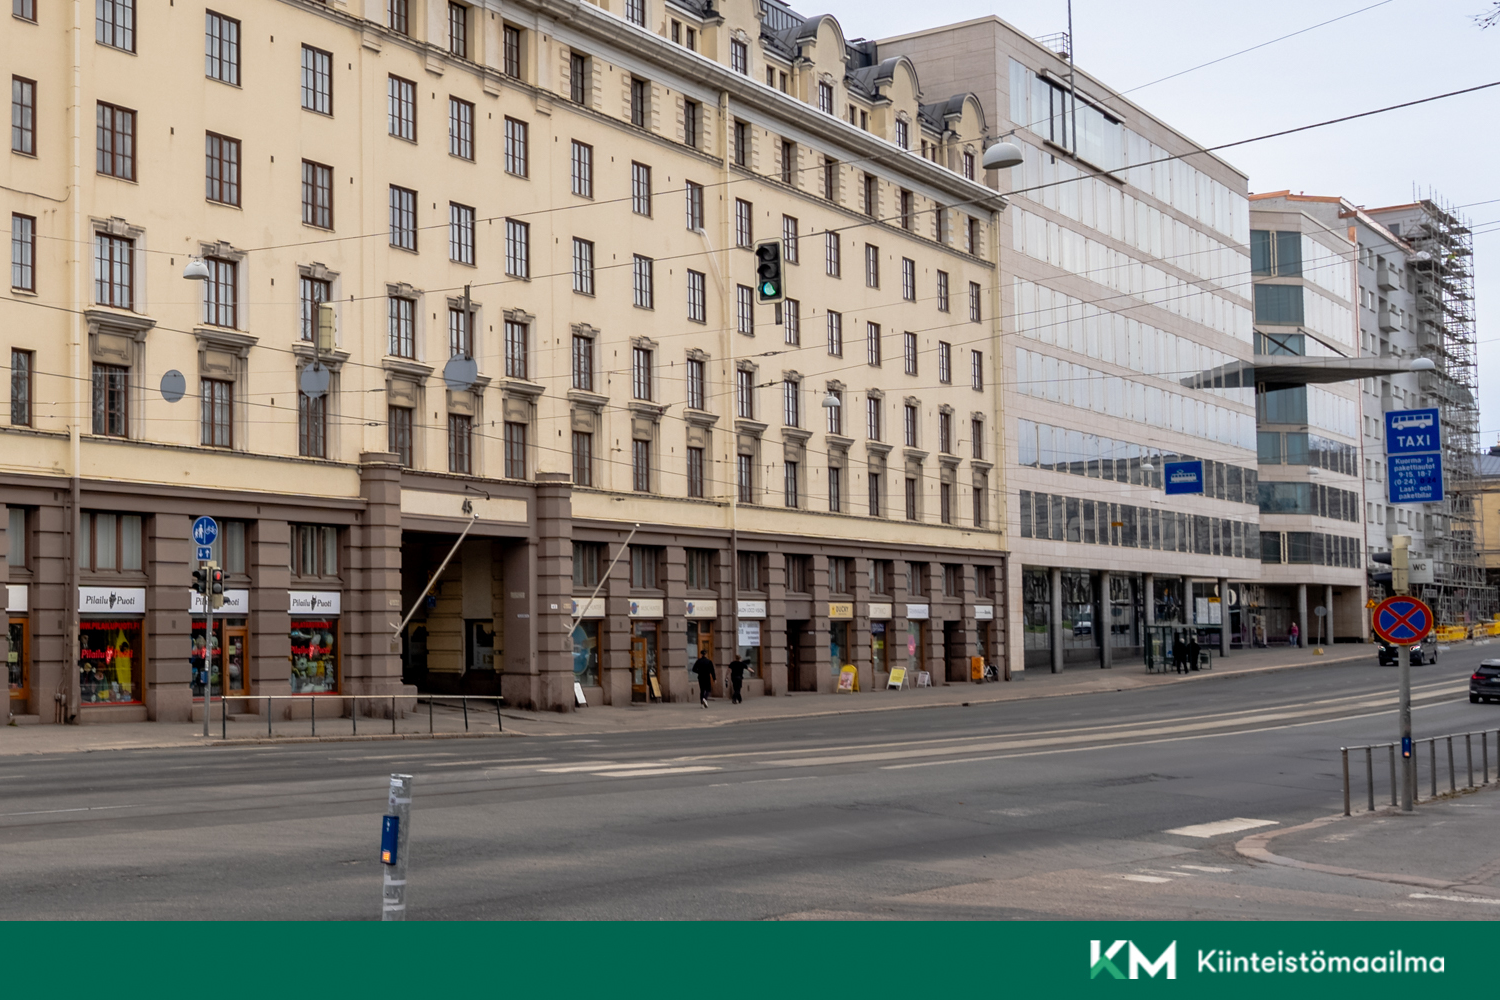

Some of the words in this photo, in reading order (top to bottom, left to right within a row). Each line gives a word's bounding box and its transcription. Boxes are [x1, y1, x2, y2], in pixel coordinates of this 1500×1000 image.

[1396, 434, 1431, 448] TAXI
[1395, 457, 1423, 465] Kuorma-
[1394, 463, 1435, 473] pakettiautot
[1399, 492, 1432, 500] paketbilar
[462, 497, 473, 514] 45
[1412, 563, 1427, 571] WC
[85, 595, 109, 605] Pilailu
[116, 596, 135, 605] Puoti
[292, 599, 311, 607] Pilailu
[317, 599, 332, 607] Puoti
[836, 605, 849, 613] DUCKY
[79, 622, 140, 630] WW.PILAILUPUOTI.FI
[81, 649, 105, 659] Pilailu
